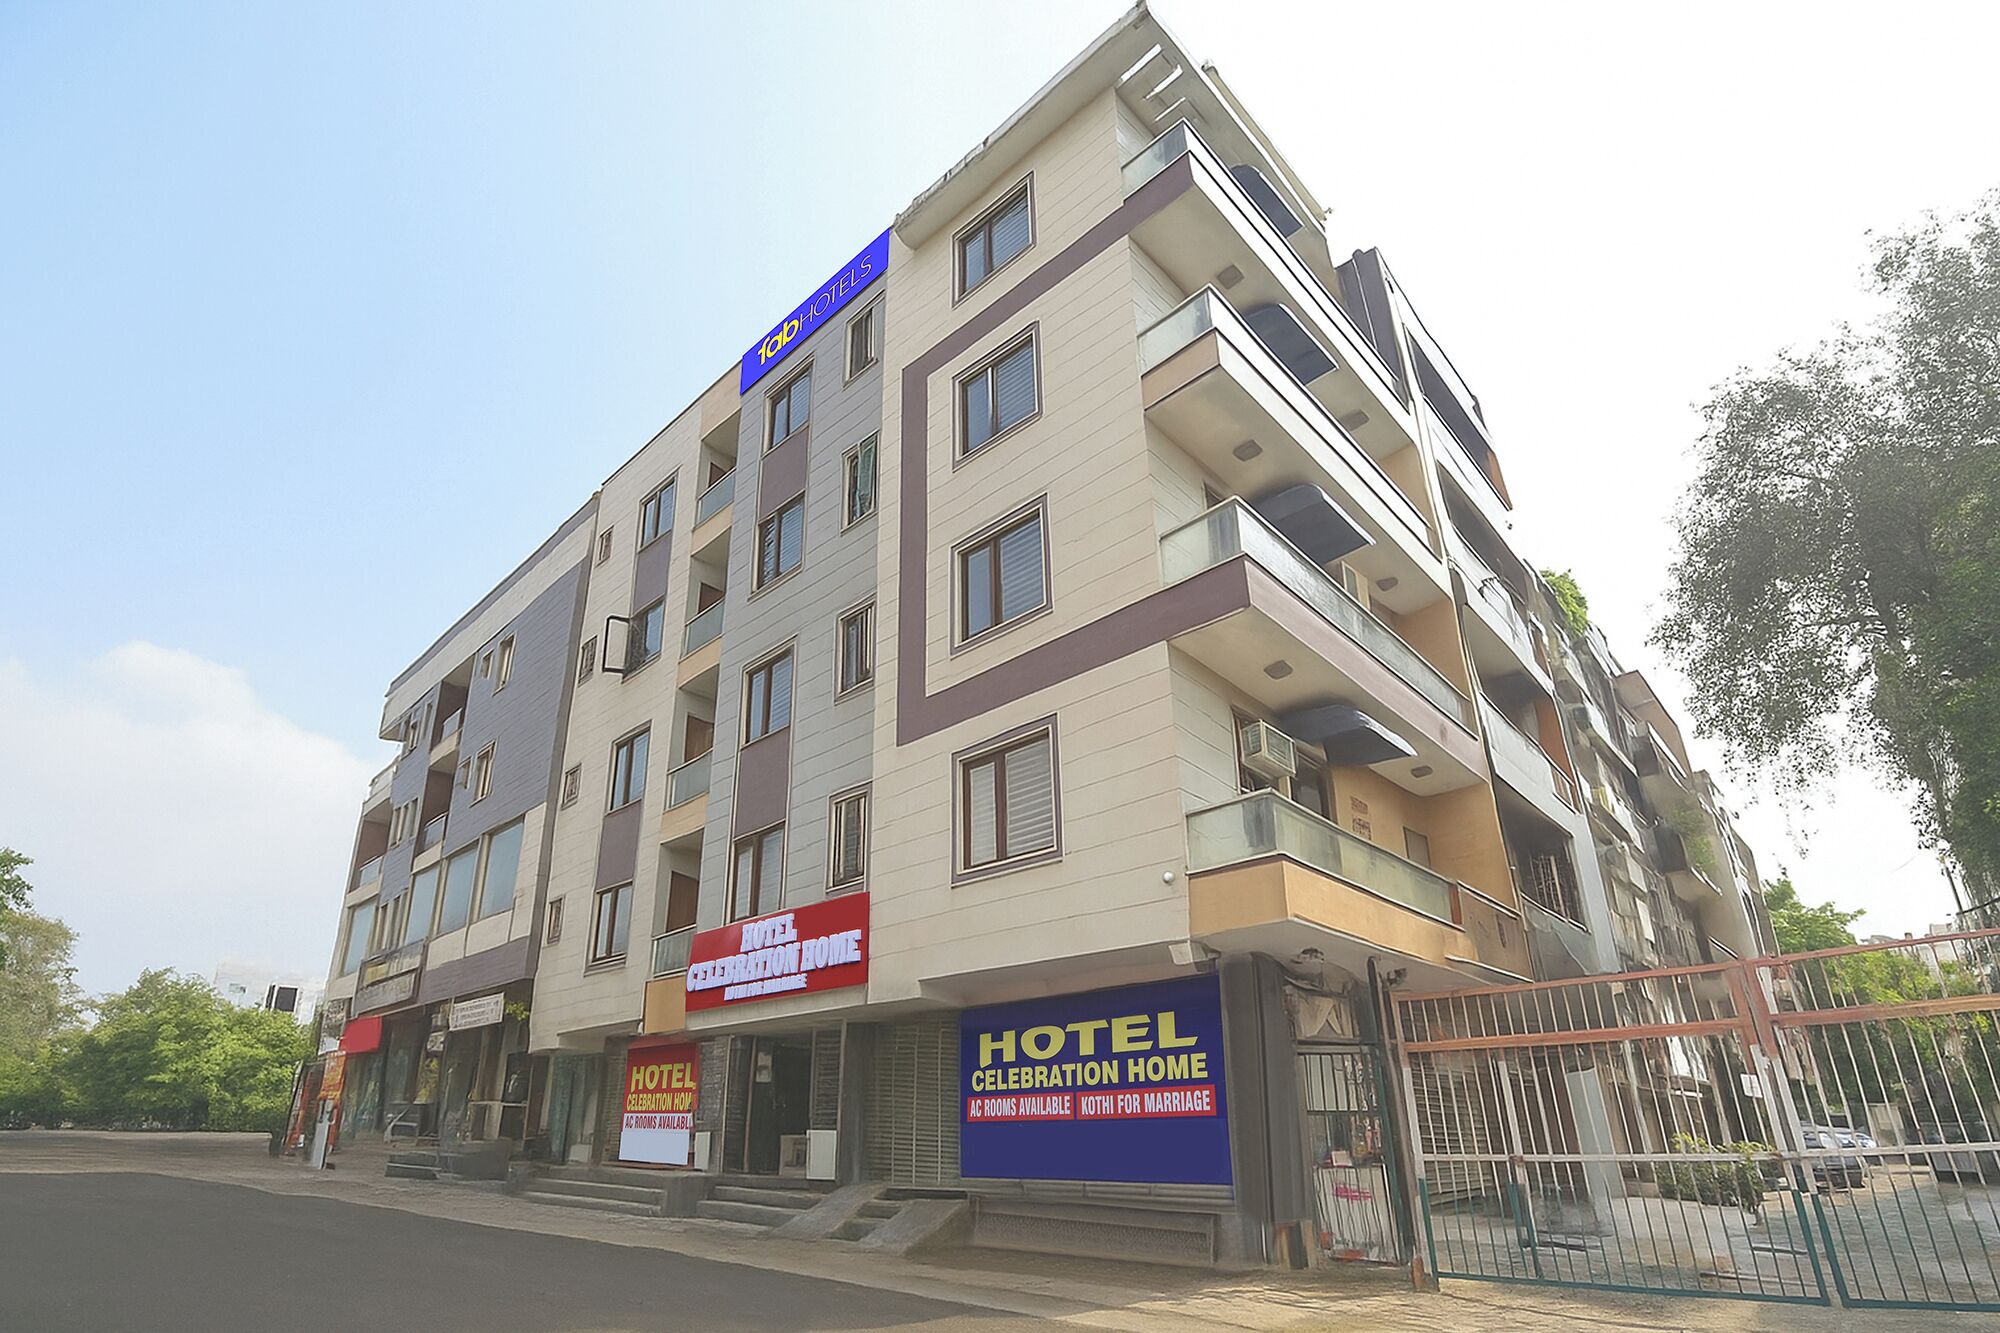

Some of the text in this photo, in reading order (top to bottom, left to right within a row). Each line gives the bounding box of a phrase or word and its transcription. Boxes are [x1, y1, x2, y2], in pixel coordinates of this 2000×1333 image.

[757, 254, 872, 367] fabHOTELS
[740, 913, 797, 952] HOTEL
[687, 942, 801, 992] CELEBRATION
[800, 929, 862, 971] HOME
[979, 1011, 1198, 1068] HOTEL
[630, 1063, 696, 1093] HOTEL
[971, 1052, 1208, 1092] CELEBRATION HOME
[626, 1092, 692, 1111] CELEBRATION HOM
[970, 1096, 1071, 1117] AC ROOMS AVAILABLE
[1081, 1090, 1211, 1115] KOTHI FOR MARRIAGE
[625, 1115, 689, 1130] AC ROOMS AVAILABL
